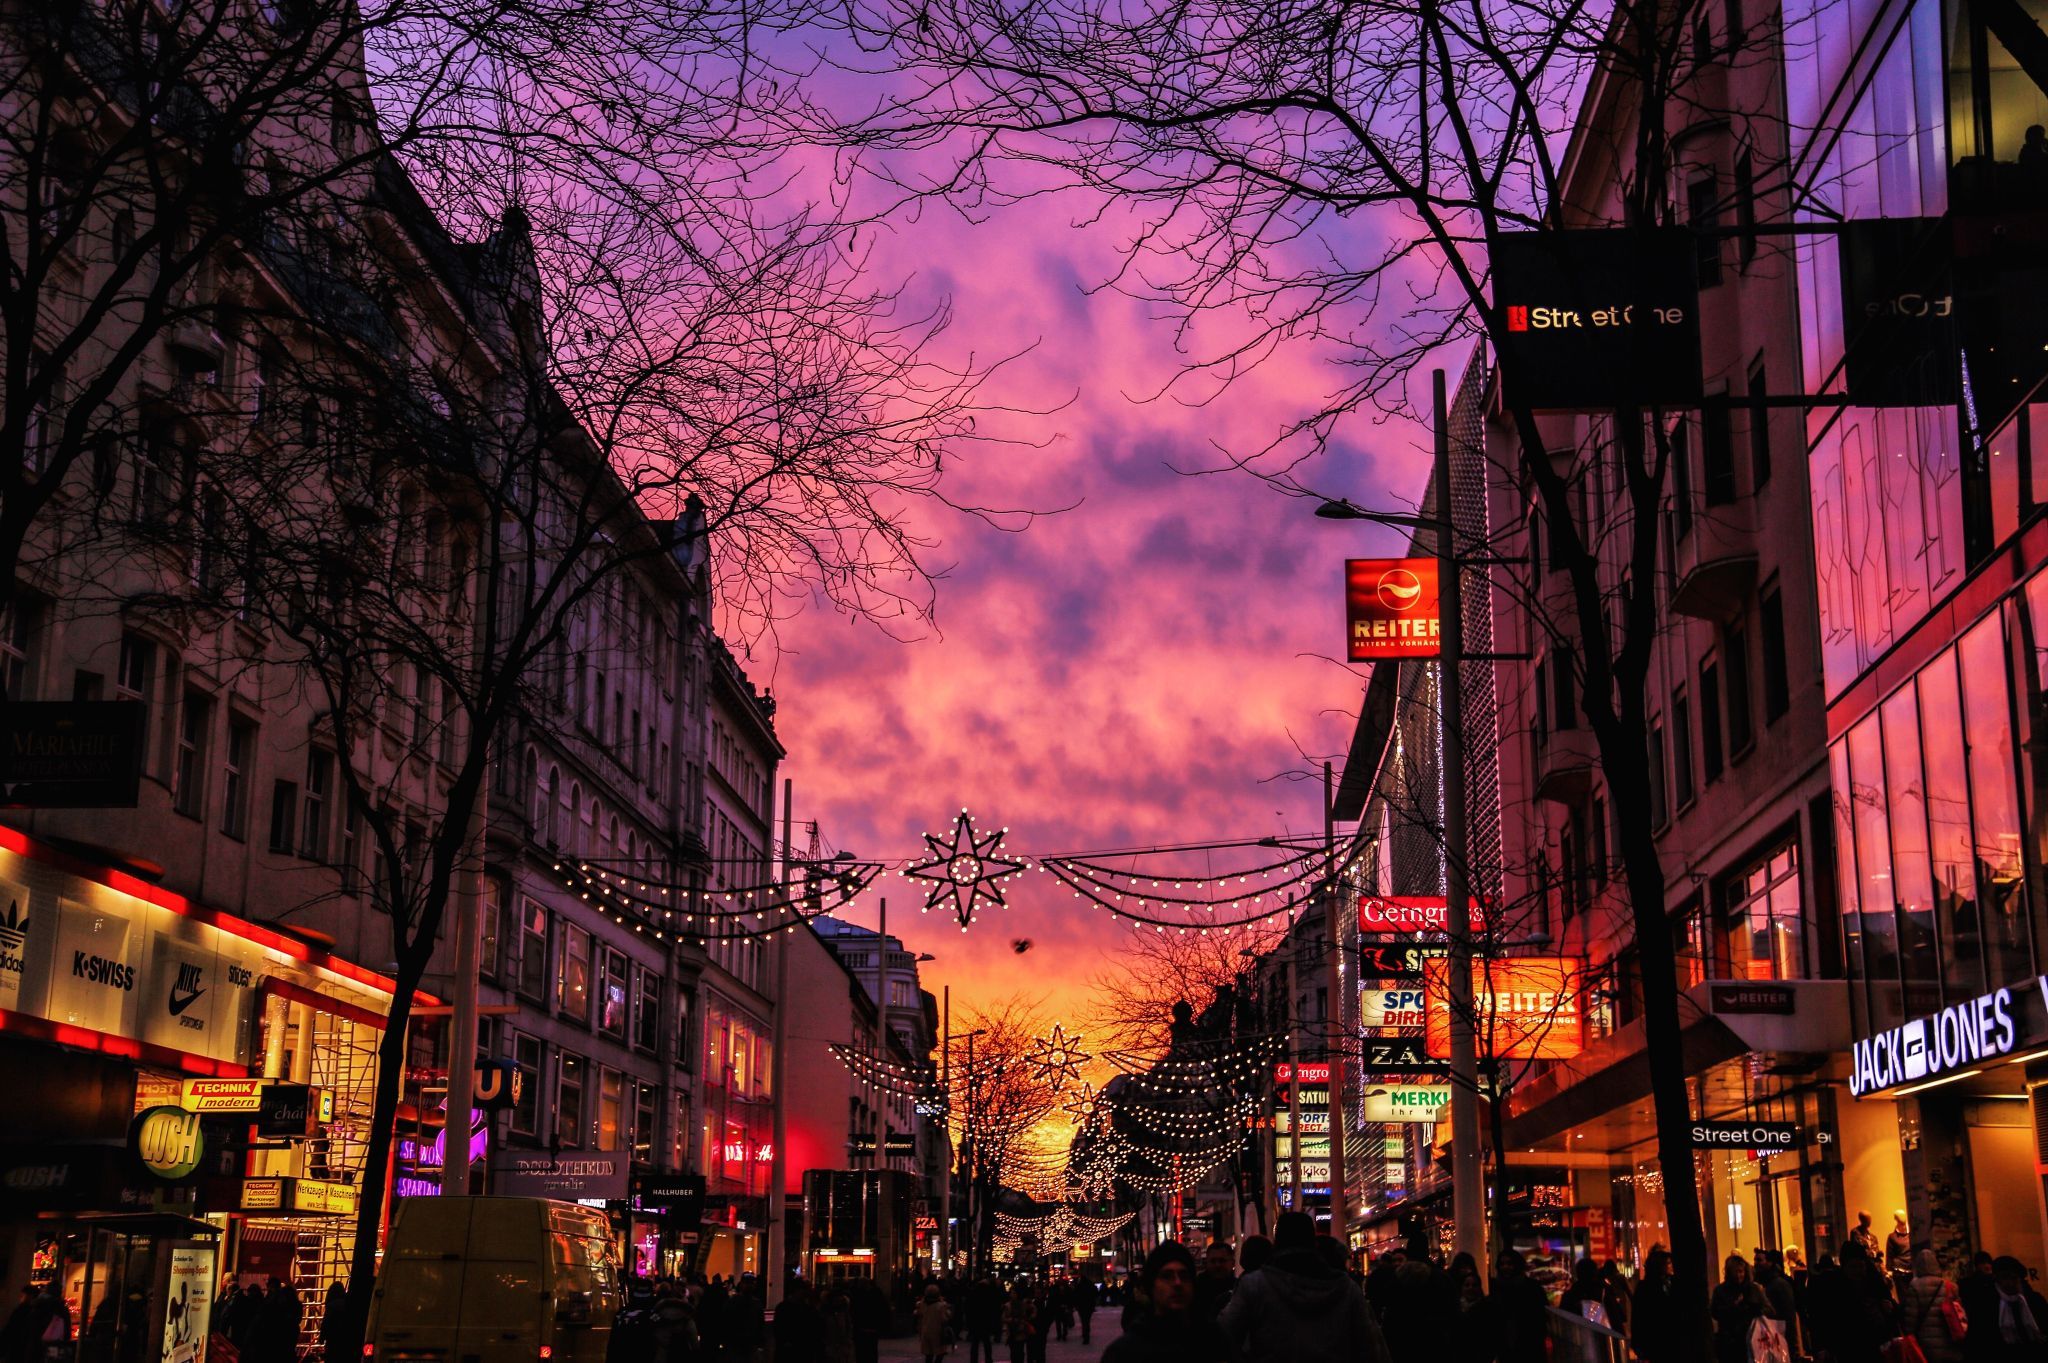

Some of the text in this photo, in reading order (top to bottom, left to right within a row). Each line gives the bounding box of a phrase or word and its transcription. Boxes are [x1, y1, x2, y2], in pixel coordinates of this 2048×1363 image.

[1354, 619, 1440, 638] REITER
[1364, 900, 1484, 928] Gerngrs
[176, 962, 202, 994] NIKE
[1739, 992, 1787, 1003] REITER
[1850, 1028, 1904, 1097] JACK
[1927, 987, 2016, 1074] JONES
[197, 1082, 252, 1093] TECHNIK
[474, 1069, 502, 1100] U
[205, 1097, 255, 1108] modern
[1298, 1090, 1330, 1104] SATU
[1391, 1091, 1448, 1106] MERK
[142, 1114, 200, 1165] LUSH
[1691, 1127, 1791, 1143] Street One
[915, 1217, 939, 1229] ZZA
